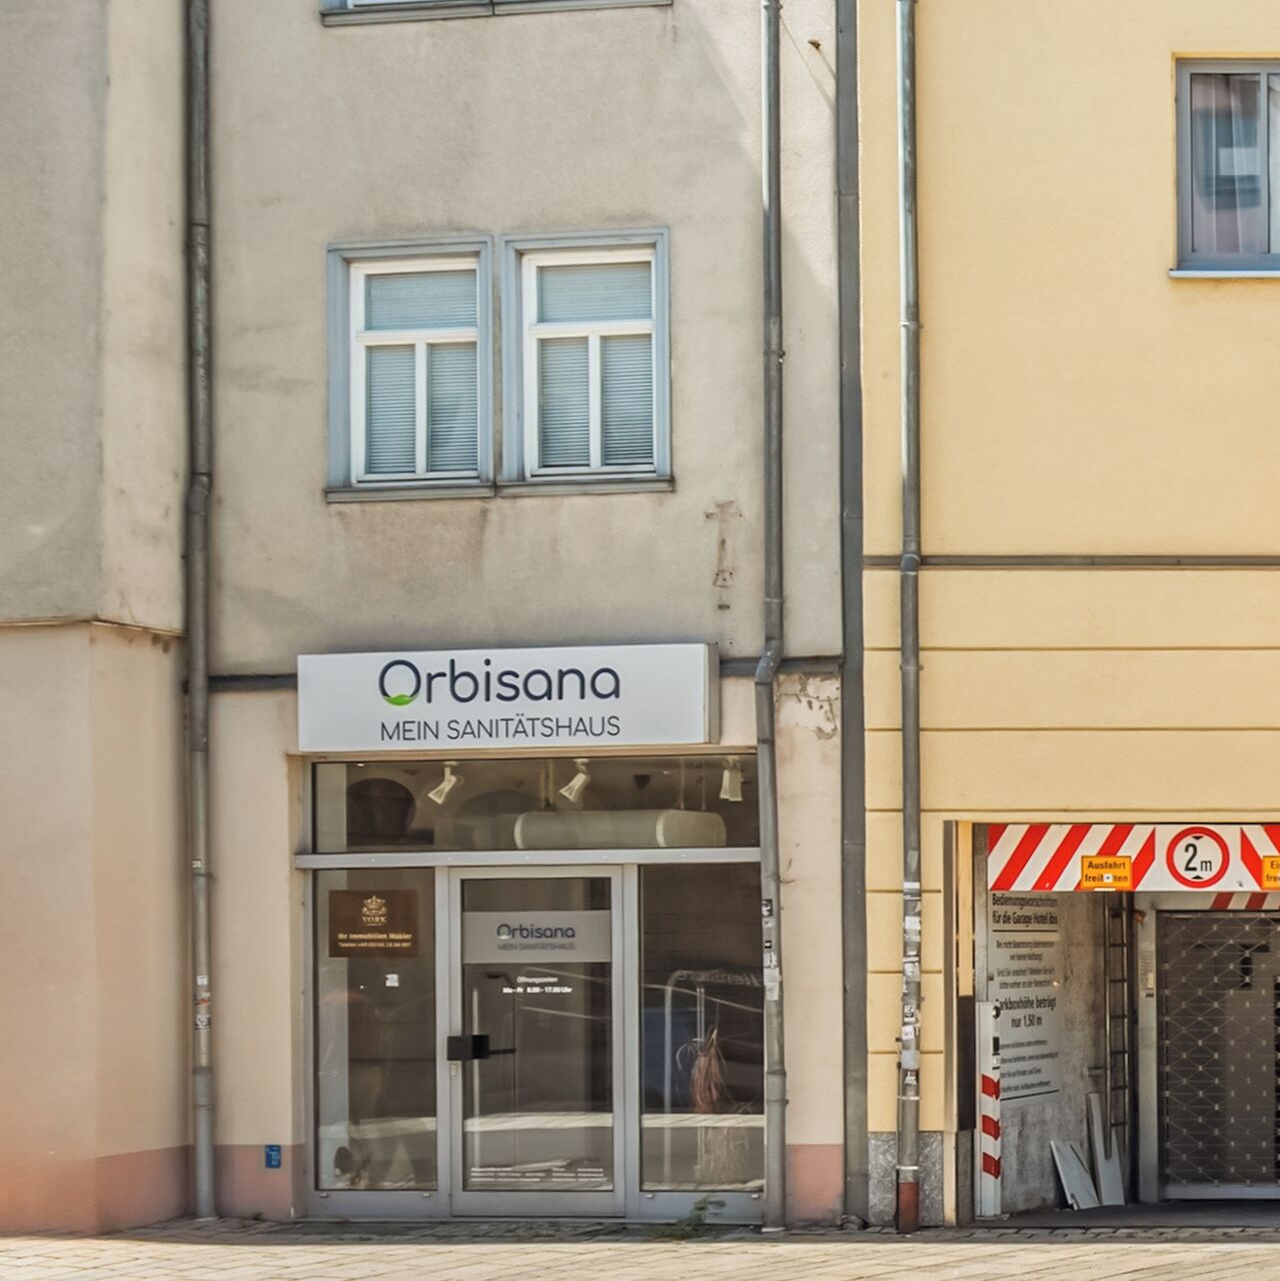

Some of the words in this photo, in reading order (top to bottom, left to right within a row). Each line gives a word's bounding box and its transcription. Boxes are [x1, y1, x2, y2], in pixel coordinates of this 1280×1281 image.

[379, 658, 621, 706] Orbisana
[381, 719, 439, 741] MEIN
[447, 713, 621, 740] SANITÄTSHAUS
[1087, 860, 1126, 870] Ausfahrt
[1184, 843, 1198, 871] 2
[1200, 860, 1212, 871] m
[496, 923, 576, 939] Orbisana
[996, 995, 1035, 1010] arkboxhöhe
